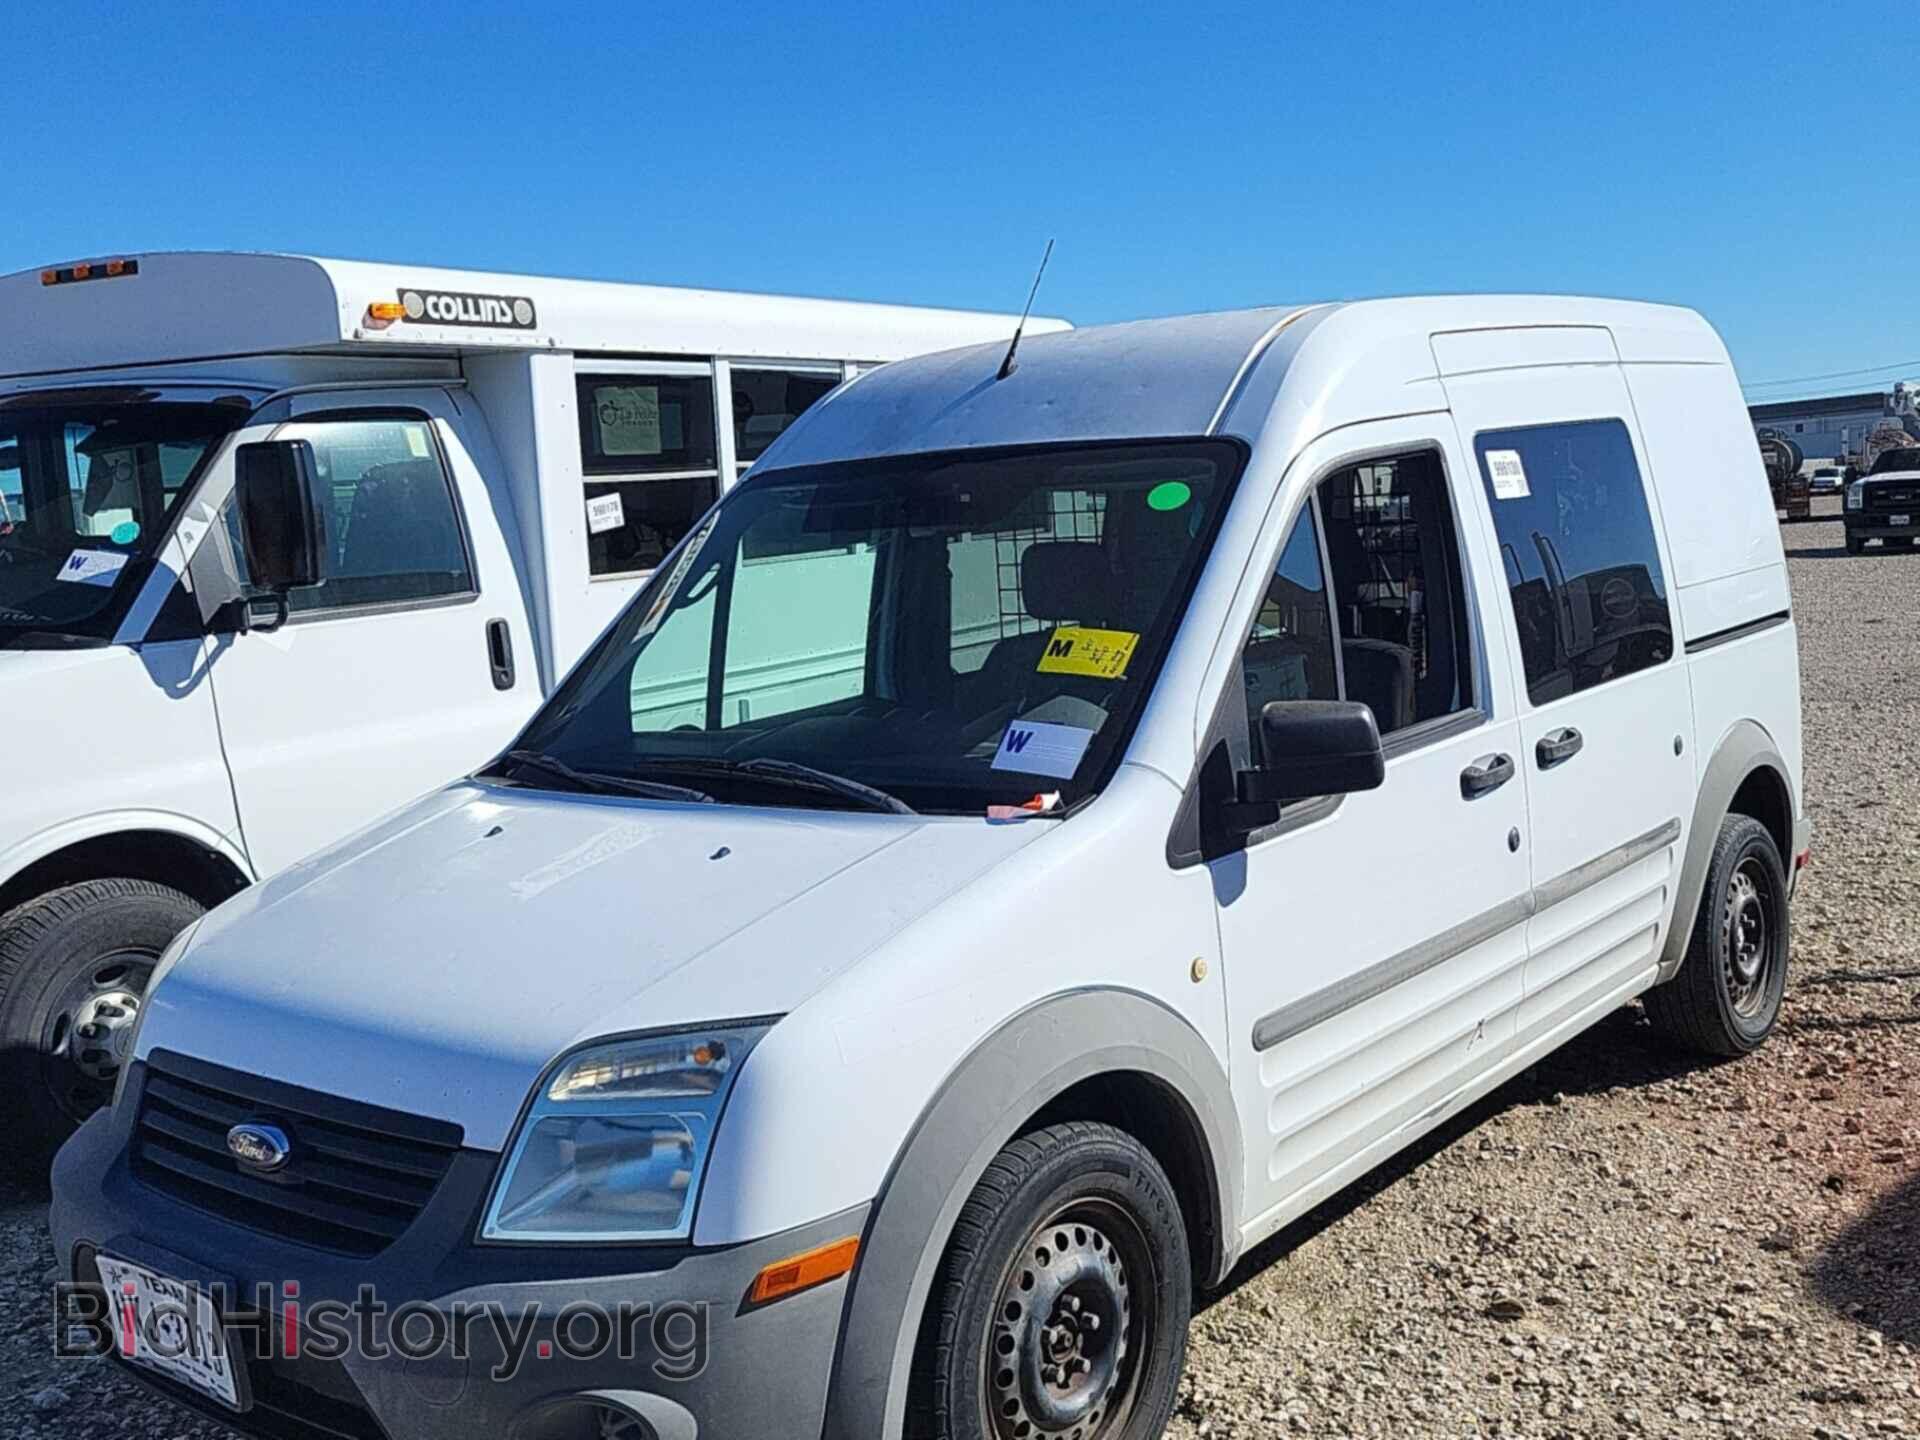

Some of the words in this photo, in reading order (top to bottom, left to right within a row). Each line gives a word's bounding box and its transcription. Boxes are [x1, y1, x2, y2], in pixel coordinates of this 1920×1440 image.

[426, 295, 513, 323] COLLINS
[69, 555, 88, 571] W
[1047, 639, 1075, 658] M
[1006, 730, 1035, 753] W
[236, 1132, 268, 1161] Ford
